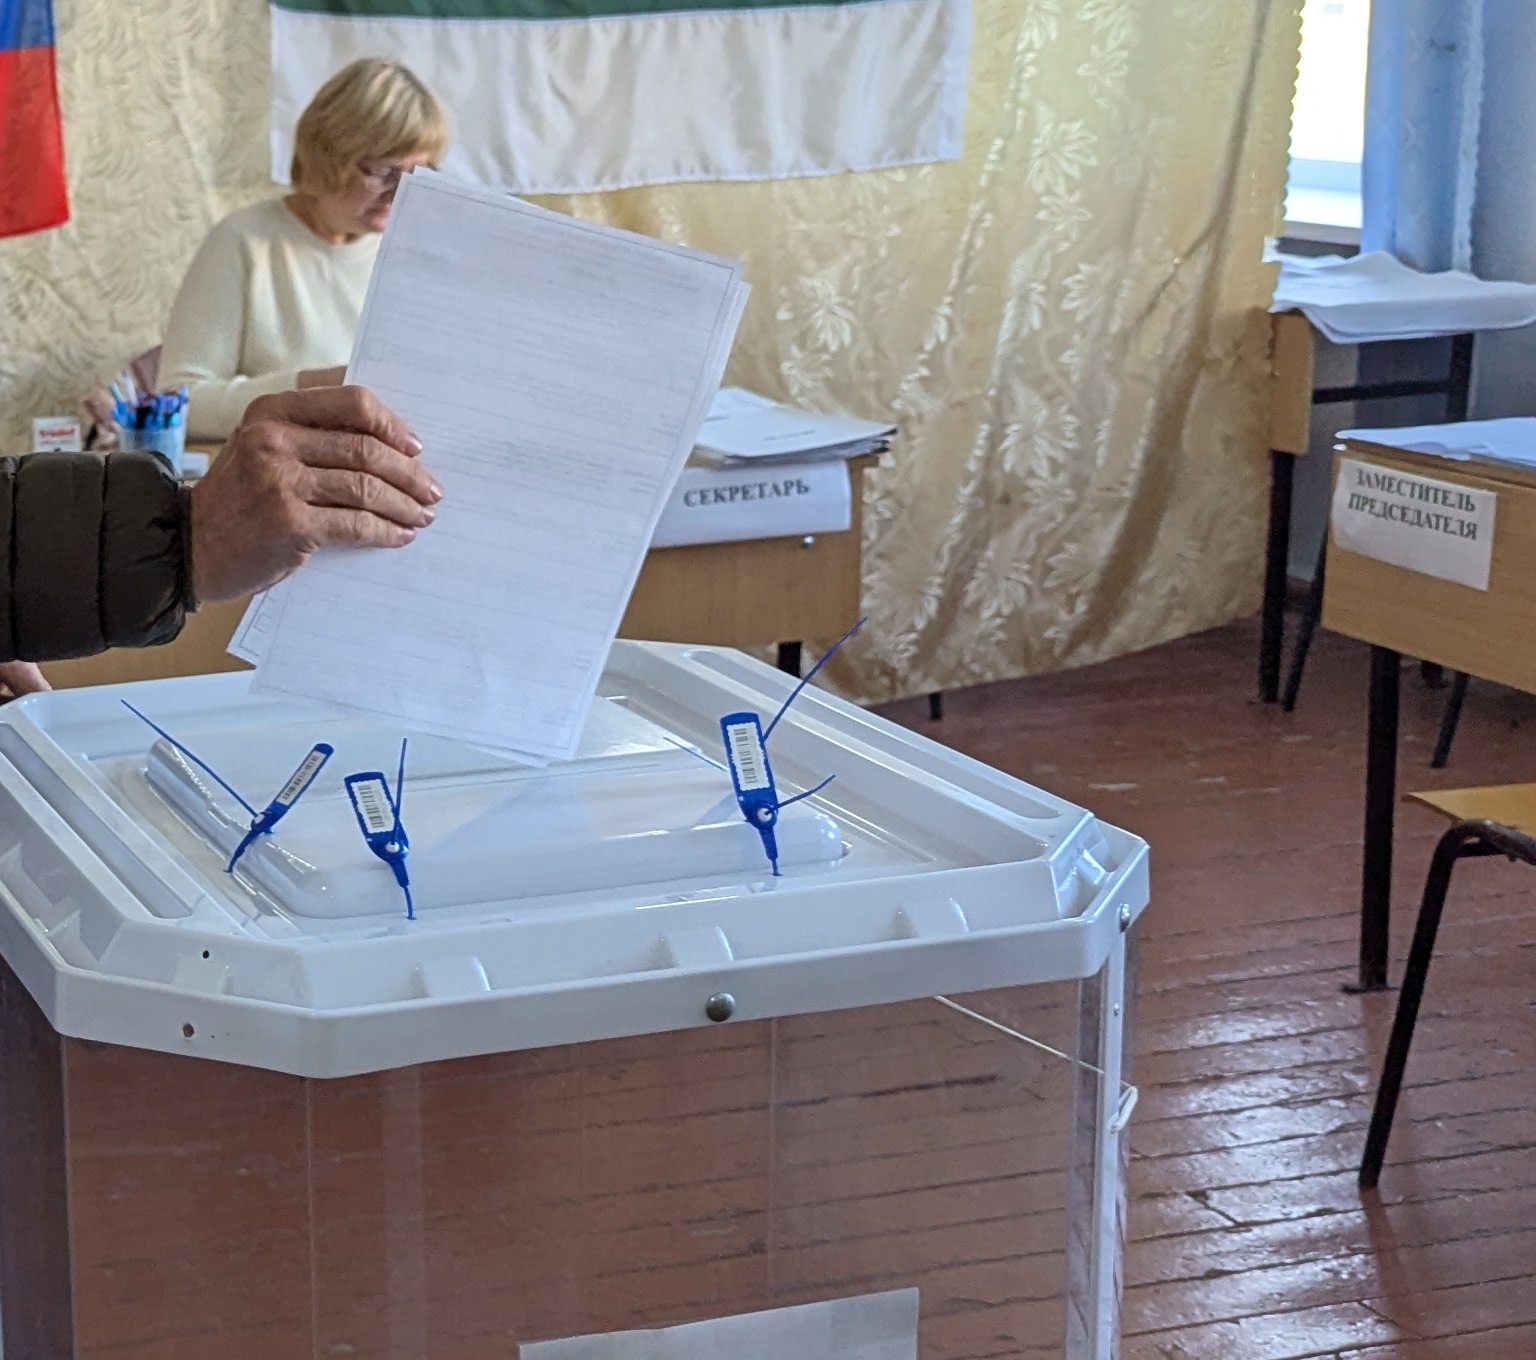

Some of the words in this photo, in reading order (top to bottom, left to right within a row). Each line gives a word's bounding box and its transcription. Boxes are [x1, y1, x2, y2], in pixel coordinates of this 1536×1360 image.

[683, 479, 810, 507] СЕКРЕТАРЬ
[1357, 469, 1476, 512] ЗАМЕСТИТЕЛЬ
[1348, 493, 1477, 540] ПРЕДСЕДАТЕЛЯ
